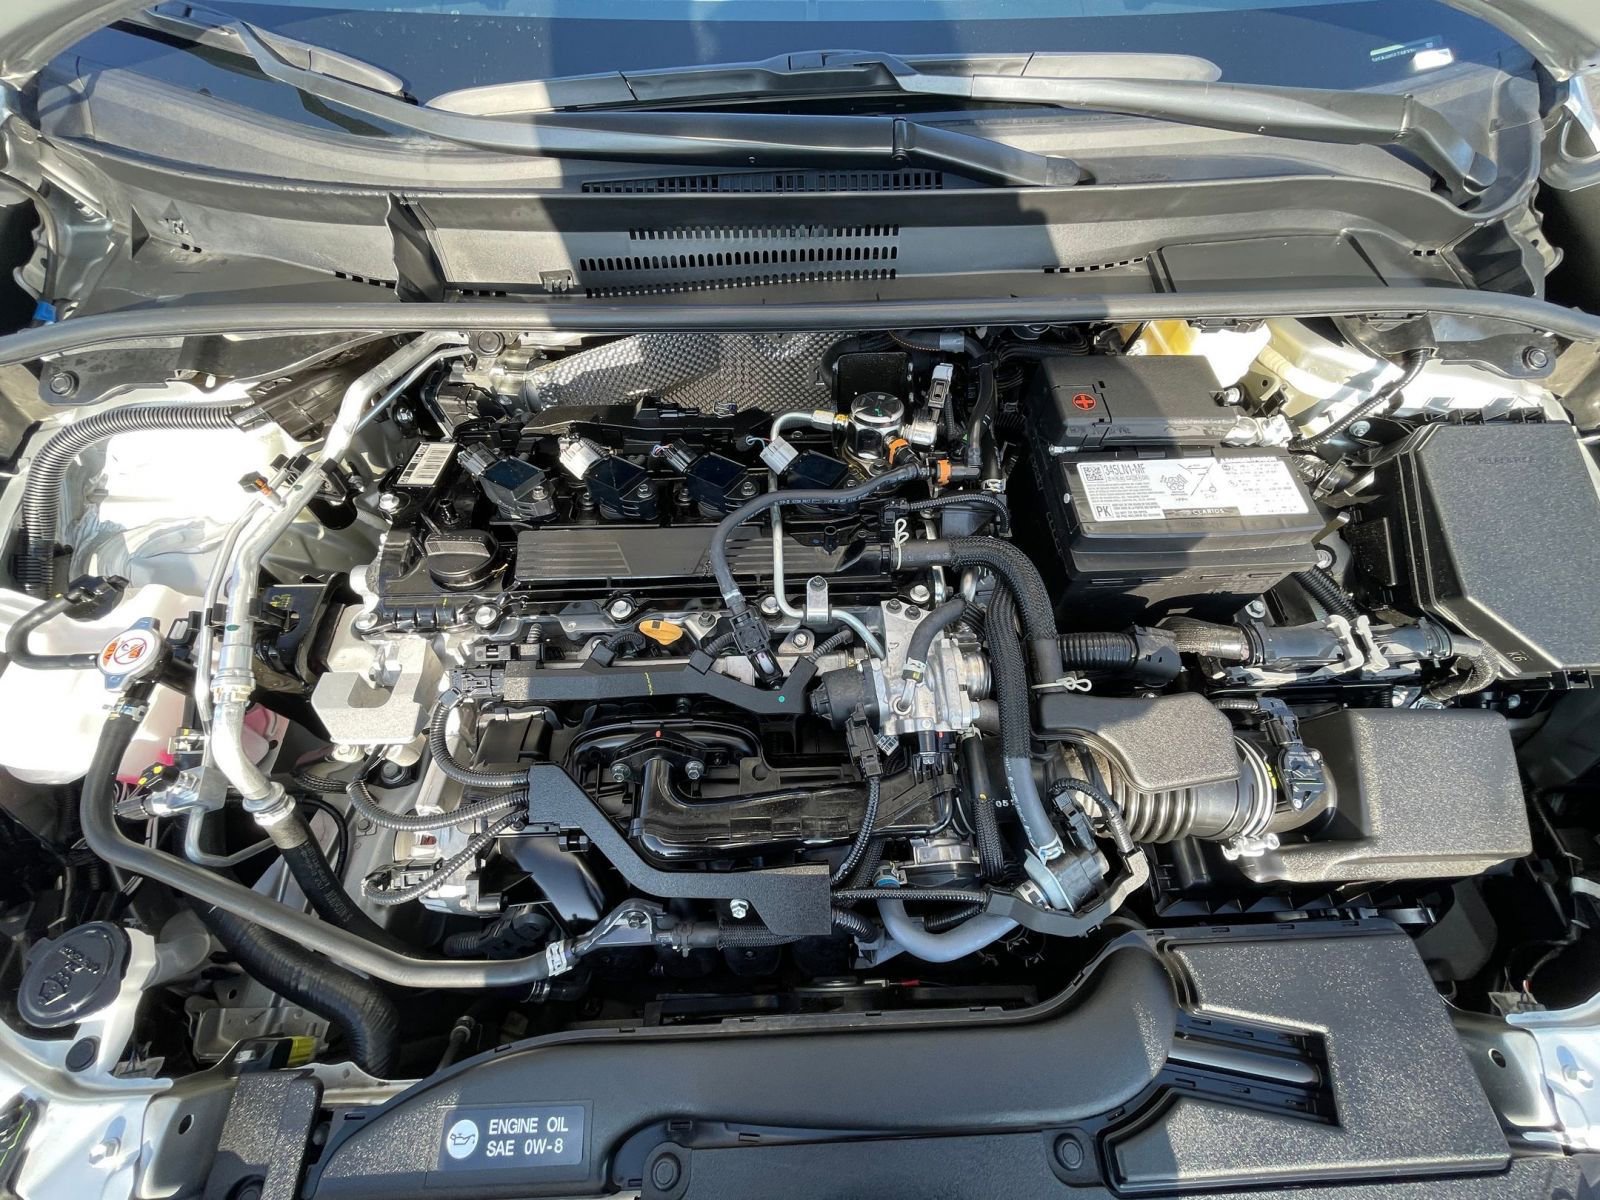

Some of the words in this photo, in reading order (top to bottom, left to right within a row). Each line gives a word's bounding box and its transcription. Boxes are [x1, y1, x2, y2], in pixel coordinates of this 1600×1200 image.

[1103, 463, 1146, 475] 345LN1-MF
[1096, 505, 1111, 517] PK
[488, 1117, 539, 1135] ENGINE
[546, 1116, 569, 1132] OIL
[486, 1140, 515, 1157] SAE
[524, 1138, 564, 1155] 0W-8
